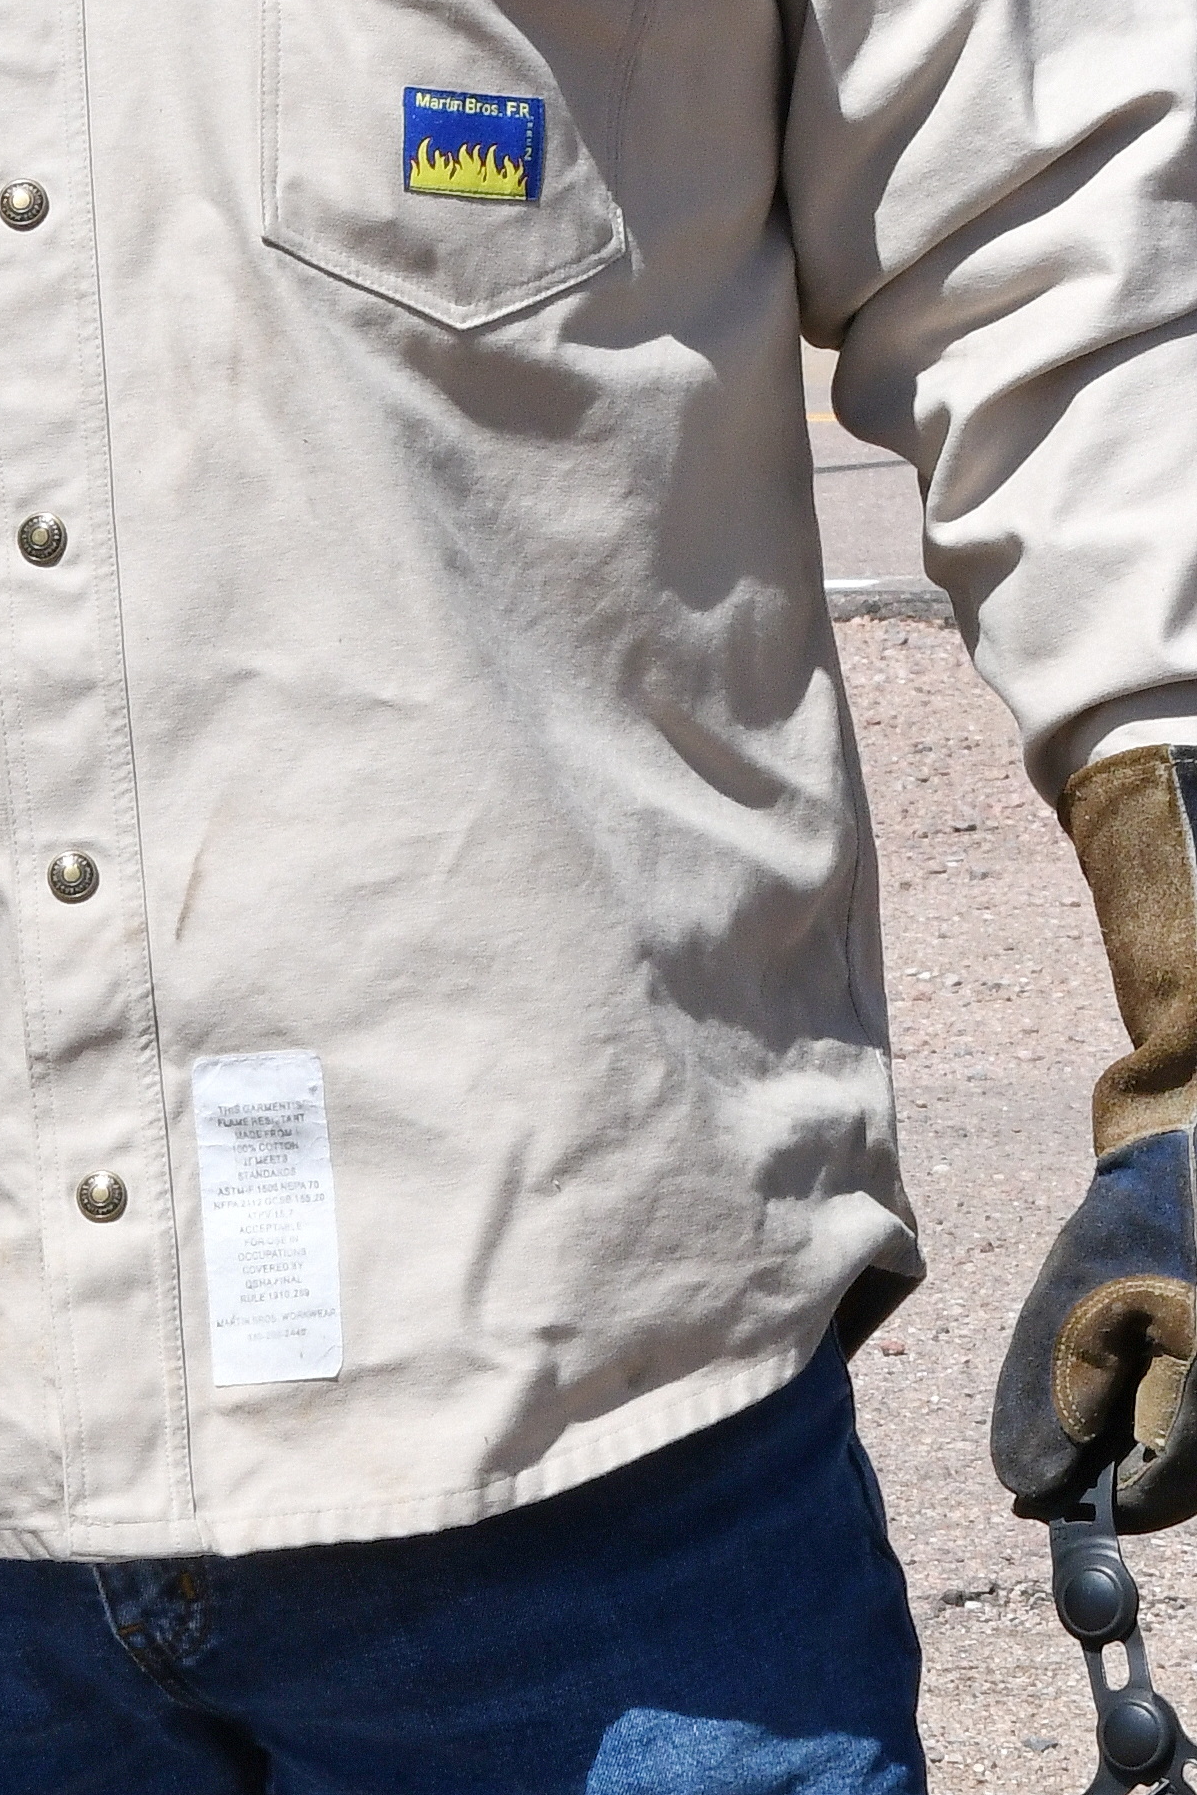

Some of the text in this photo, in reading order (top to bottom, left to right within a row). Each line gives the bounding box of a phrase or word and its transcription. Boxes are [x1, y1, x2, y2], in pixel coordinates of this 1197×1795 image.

[415, 91, 463, 112] Martin
[465, 96, 503, 117] Bros.
[524, 147, 533, 161] 2
[218, 1105, 240, 1115] THIS
[242, 1102, 292, 1113] GARMENT
[217, 1114, 304, 1127] FLAME RESISTANT
[235, 1128, 292, 1139] MADE FROM
[233, 1141, 299, 1153] 100% COTTON
[254, 1154, 288, 1165] MEETS
[238, 1167, 296, 1181] STANDARDS
[308, 1180, 319, 1189] 70
[213, 1199, 238, 1209] NFPA
[245, 1238, 265, 1247] FOR
[238, 1248, 307, 1262] OCCUPATIONS
[242, 1262, 304, 1275] COVERED BY
[241, 1292, 265, 1303] RULE
